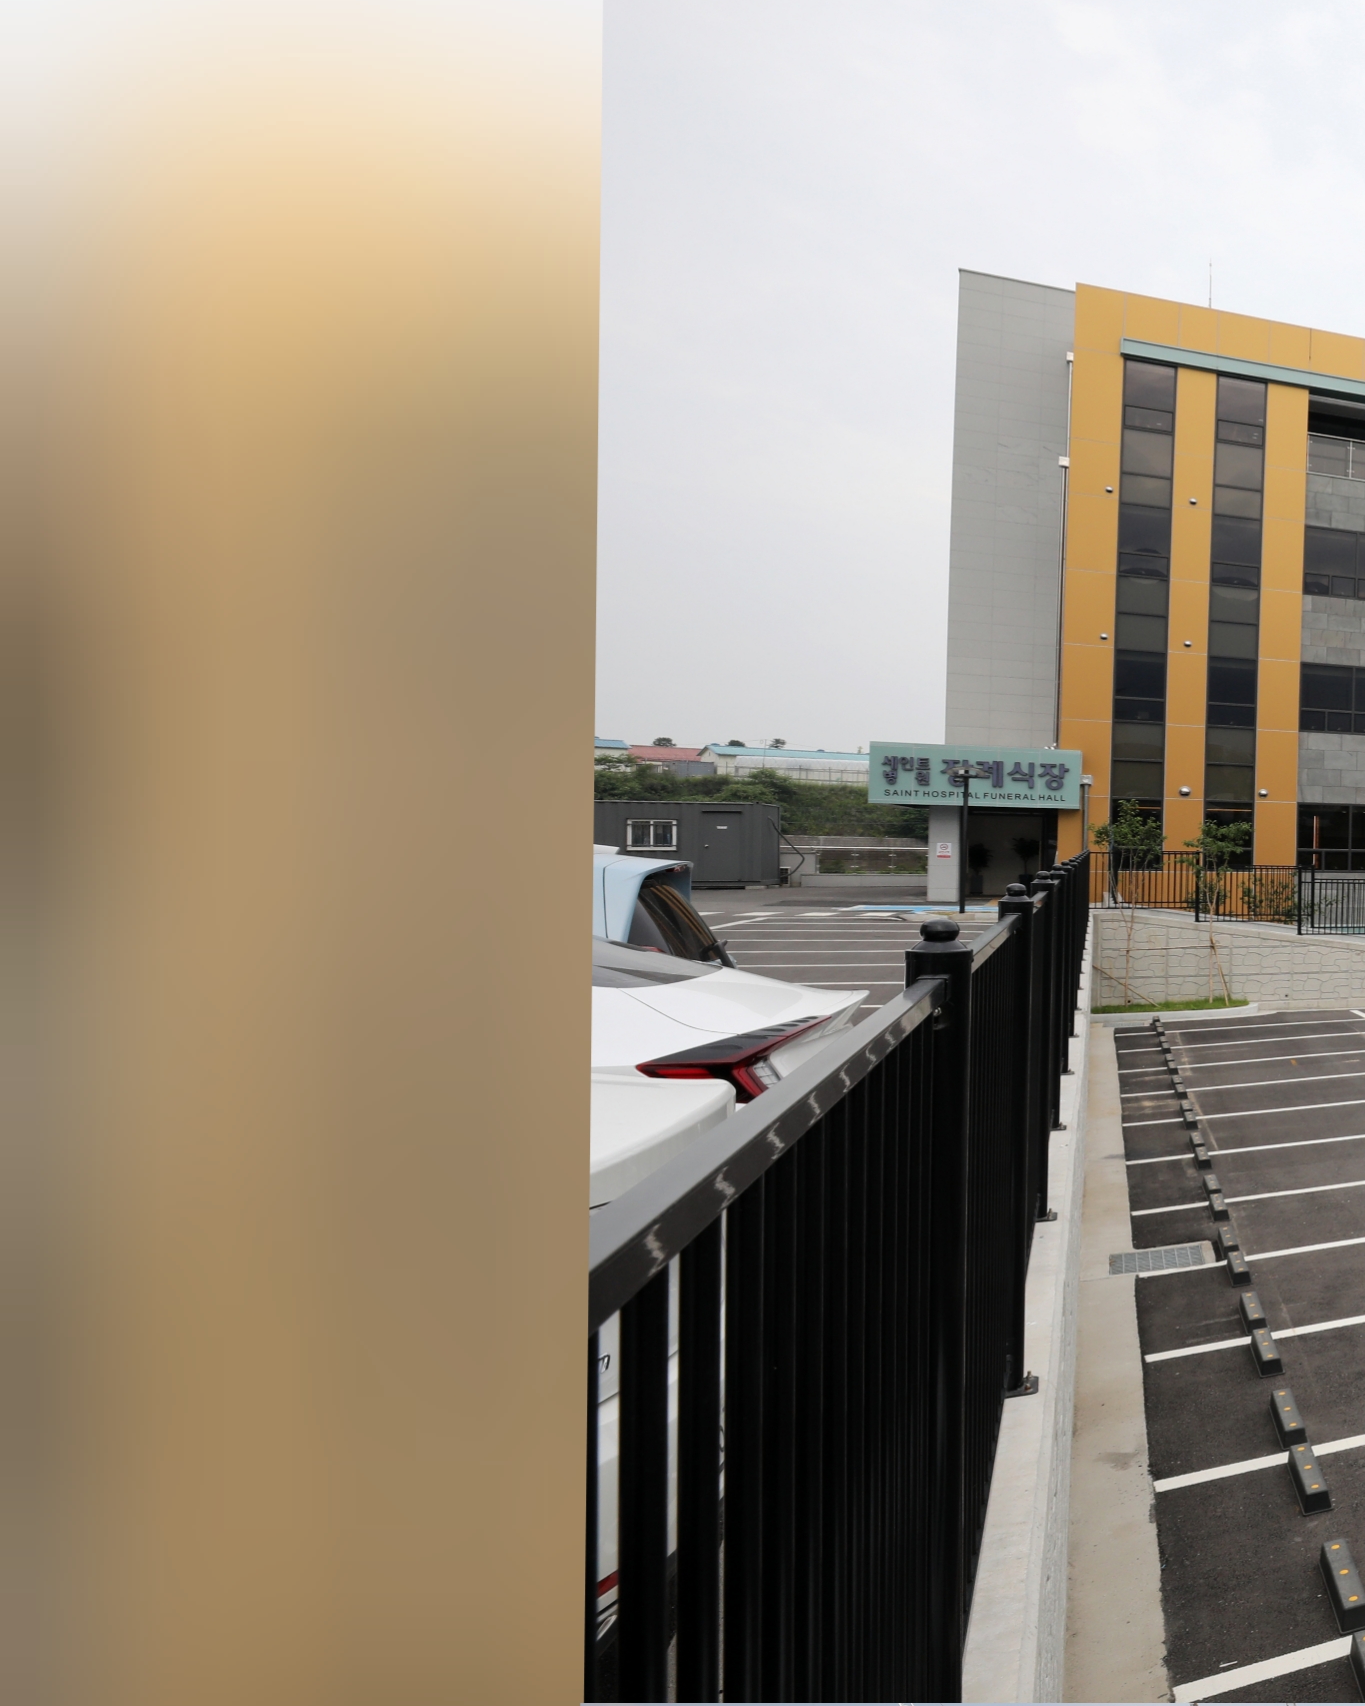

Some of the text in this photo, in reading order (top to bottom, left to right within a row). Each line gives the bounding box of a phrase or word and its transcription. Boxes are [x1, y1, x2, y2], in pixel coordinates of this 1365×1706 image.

[882, 755, 930, 771] 세인트
[940, 759, 1070, 790] 장례식장
[884, 789, 919, 797] SAINT
[983, 792, 1036, 800] FUNERAL
